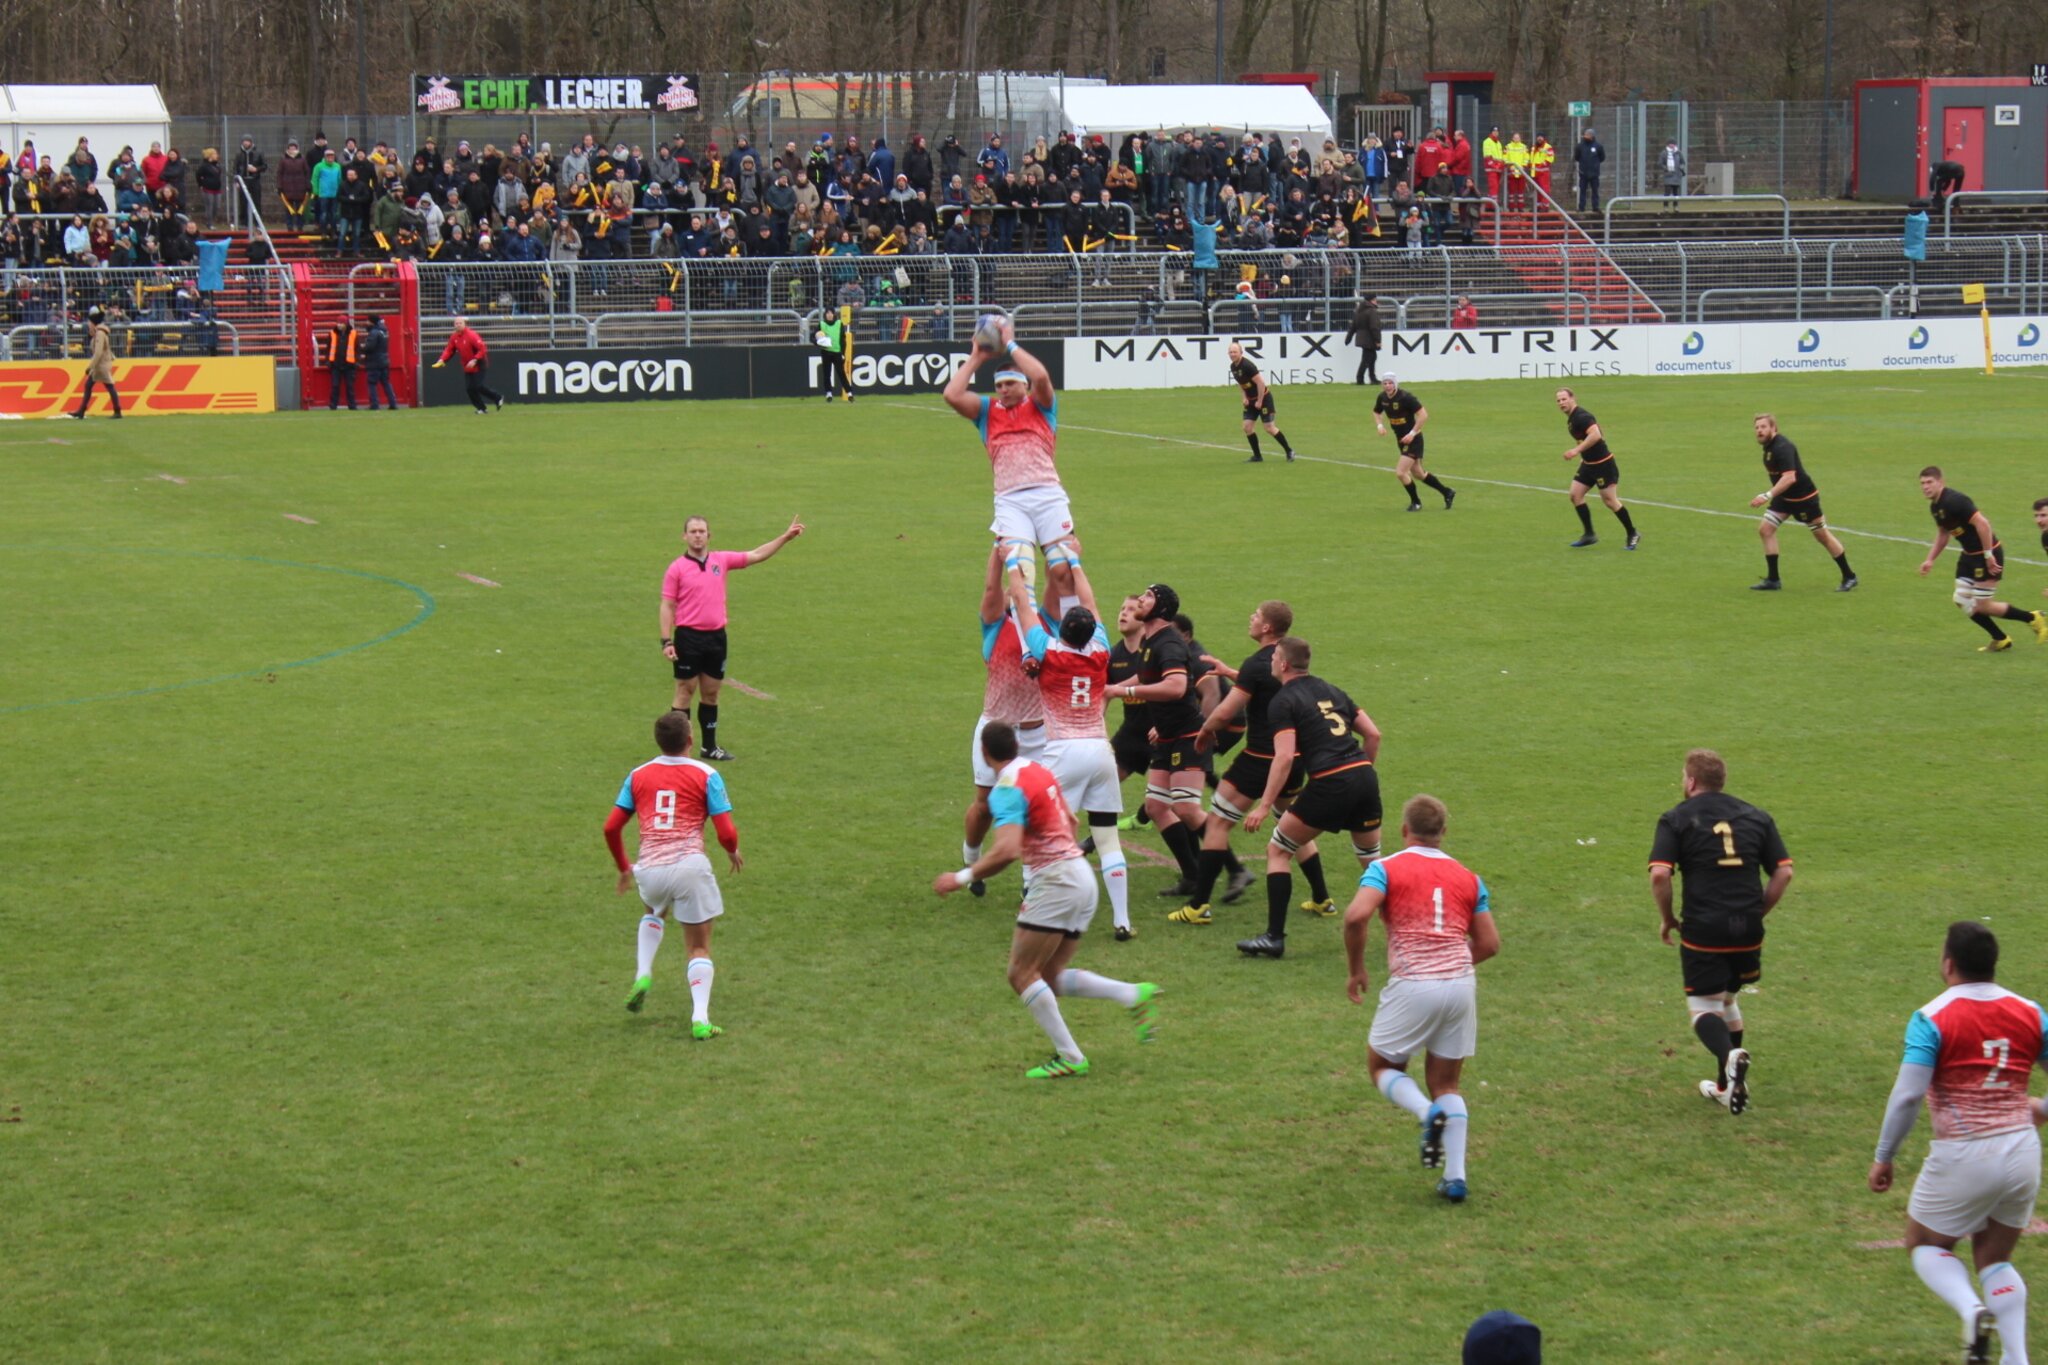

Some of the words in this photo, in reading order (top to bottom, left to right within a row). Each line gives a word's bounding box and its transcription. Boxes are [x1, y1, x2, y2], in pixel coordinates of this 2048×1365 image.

[463, 79, 538, 110] ECHT.
[545, 78, 650, 109] LECKER.
[2032, 75, 2048, 86] WC
[1095, 335, 1332, 362] MATRIX
[1392, 328, 1619, 356] MATRIX
[1520, 361, 1621, 378] FITNESS
[1655, 360, 1732, 371] documentus
[1770, 357, 1846, 369] documentus
[1883, 354, 1955, 366] documentus
[0, 364, 215, 414] DHL
[518, 359, 692, 394] macron
[1228, 368, 1334, 385] FNESS
[1071, 676, 1091, 707] 8
[1317, 700, 1346, 736] 5
[654, 789, 676, 829] 9
[1713, 821, 1743, 865] 1
[1432, 887, 1442, 932] 1
[1982, 1038, 2009, 1088] 2
